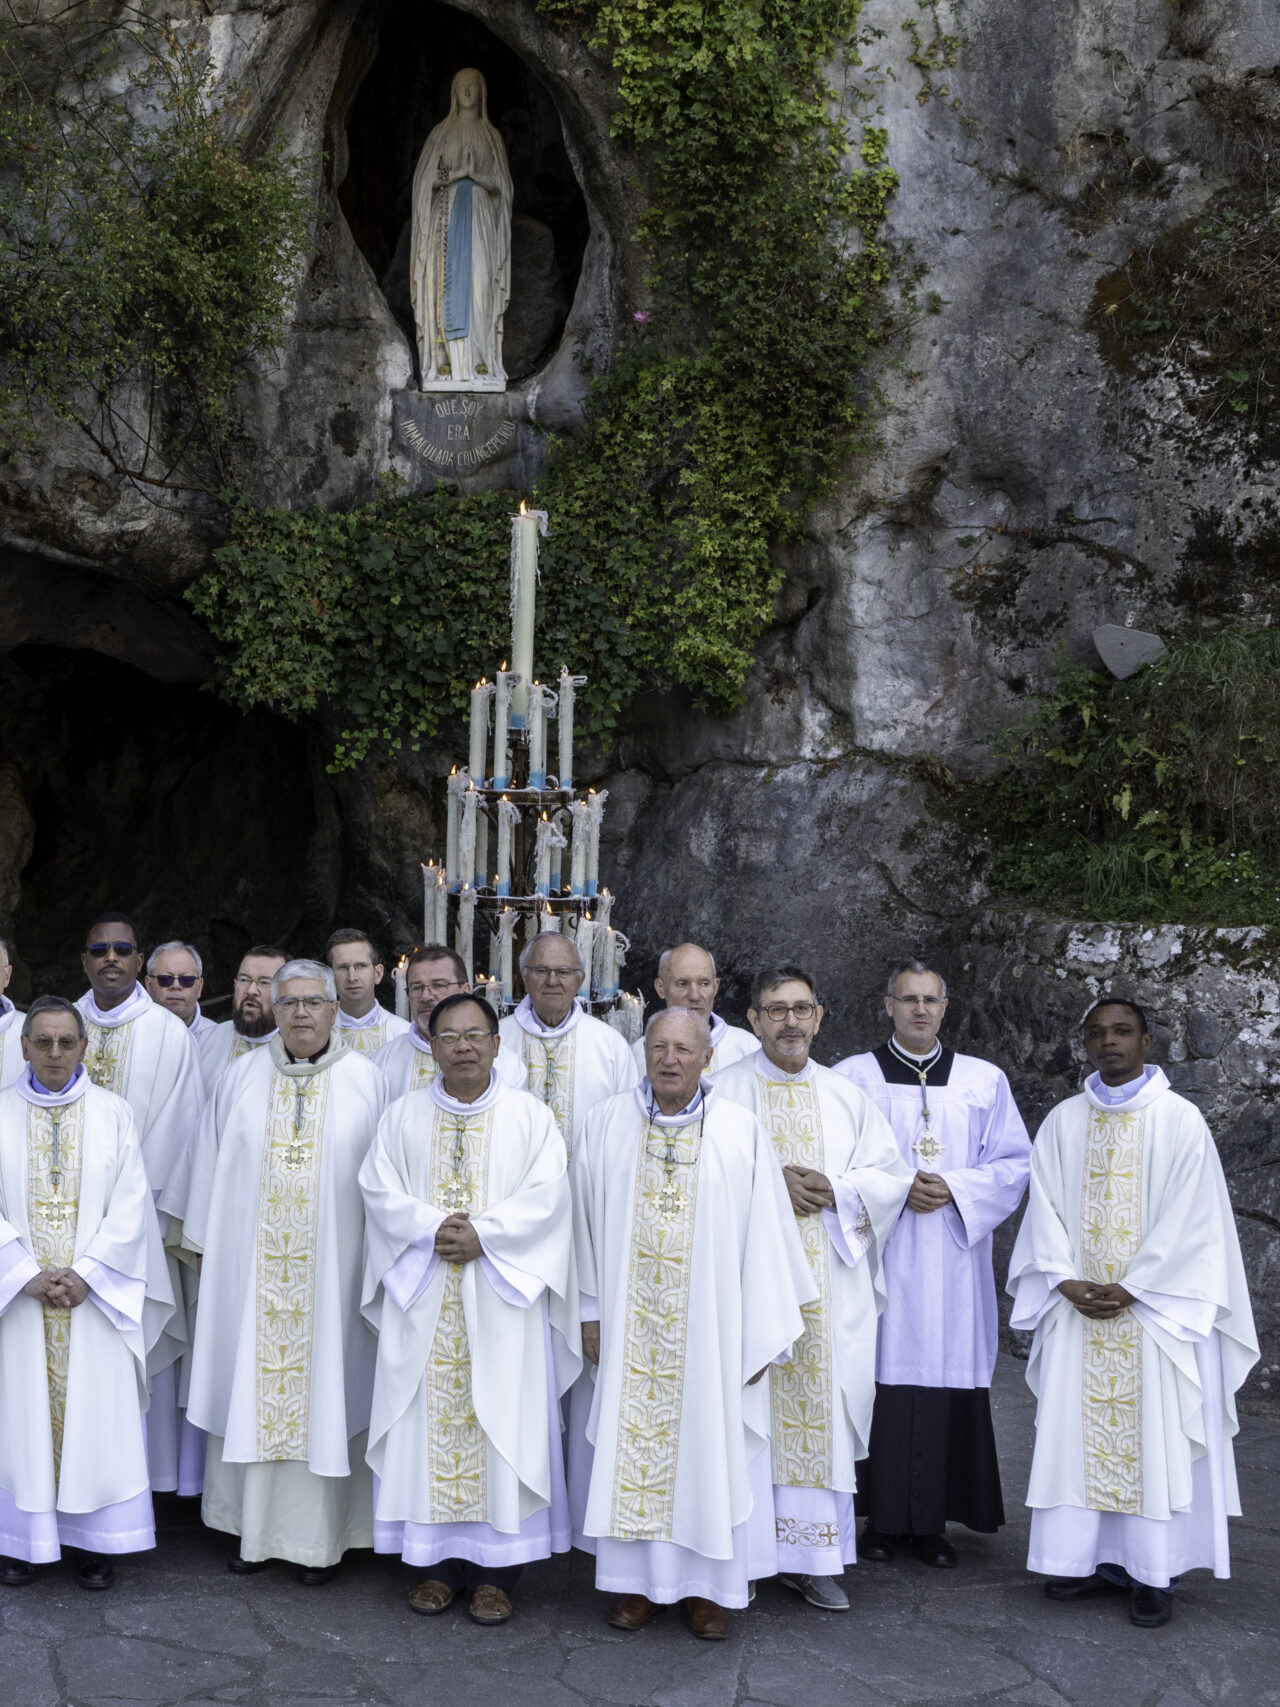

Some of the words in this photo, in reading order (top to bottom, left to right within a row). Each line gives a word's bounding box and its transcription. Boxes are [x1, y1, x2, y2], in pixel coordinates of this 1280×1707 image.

[435, 399, 457, 418] QUE
[460, 399, 484, 418] SOY
[400, 419, 455, 466] IMMACULADA
[457, 420, 516, 466] COUNCEPCIOU
[447, 426, 470, 441] ERA
